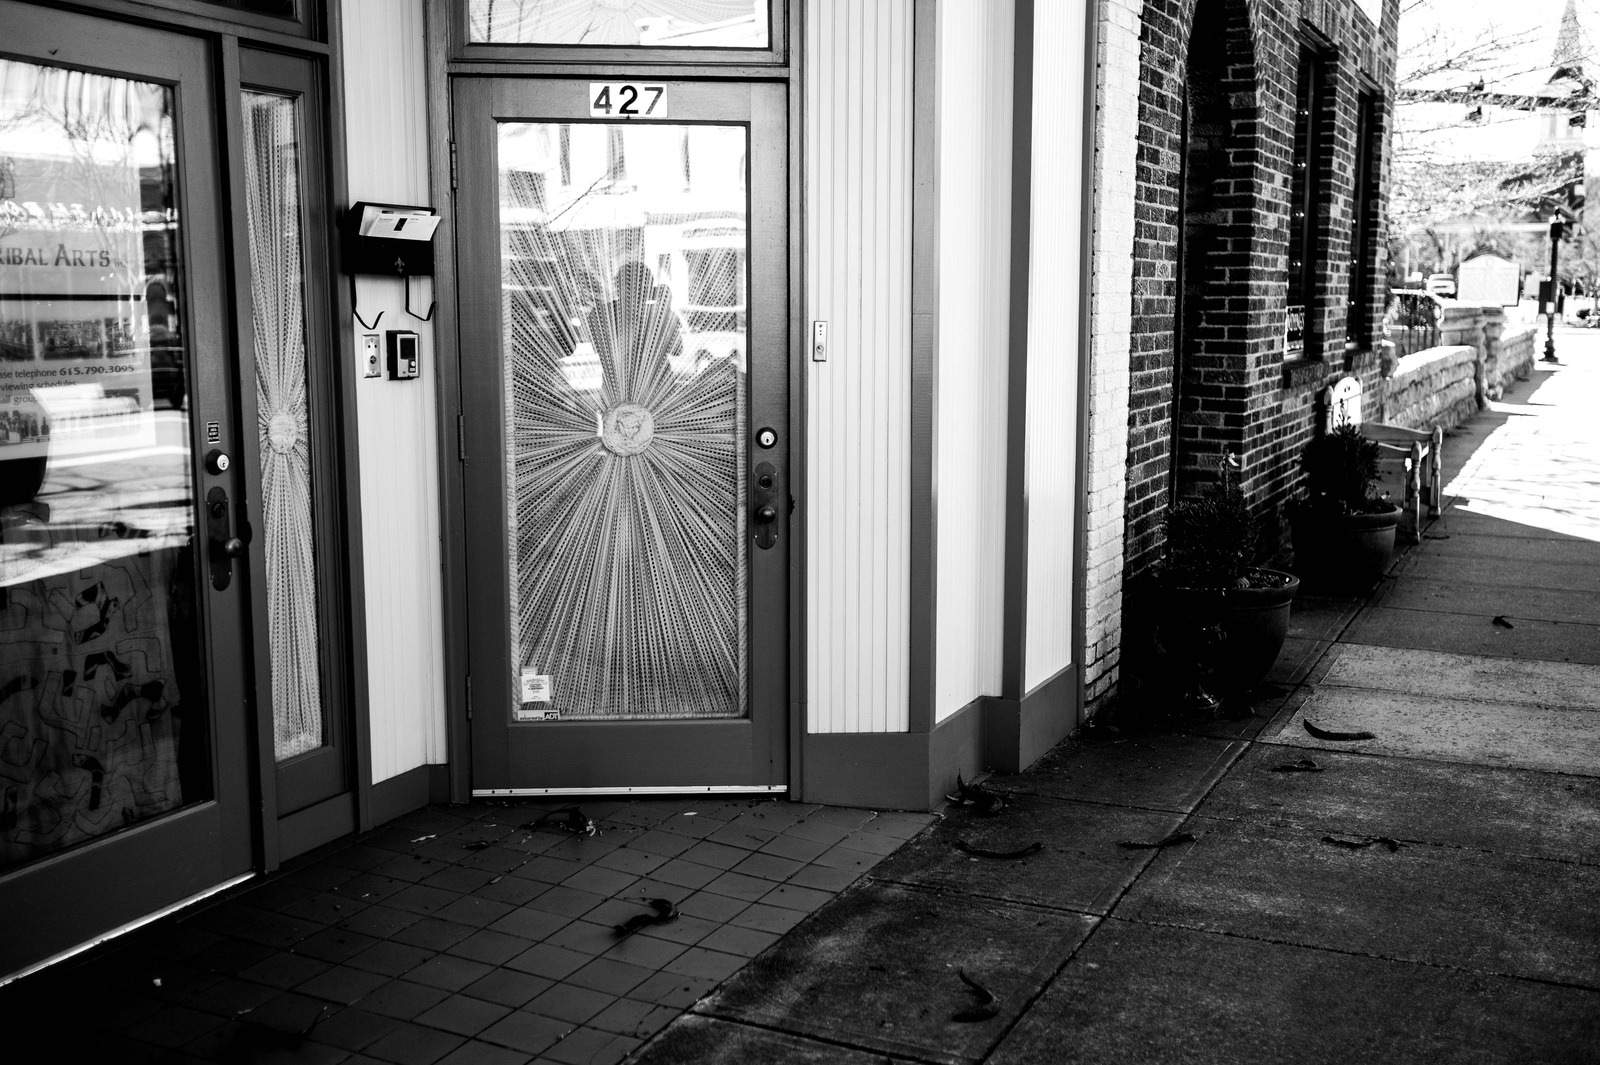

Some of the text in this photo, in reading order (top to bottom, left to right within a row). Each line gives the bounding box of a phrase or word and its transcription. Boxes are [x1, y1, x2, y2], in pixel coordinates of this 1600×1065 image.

[593, 85, 664, 114] 427
[54, 243, 111, 267] ARTS
[15, 368, 57, 379] telephone
[59, 365, 135, 376] 615.790.3095
[544, 712, 558, 720] ADT
